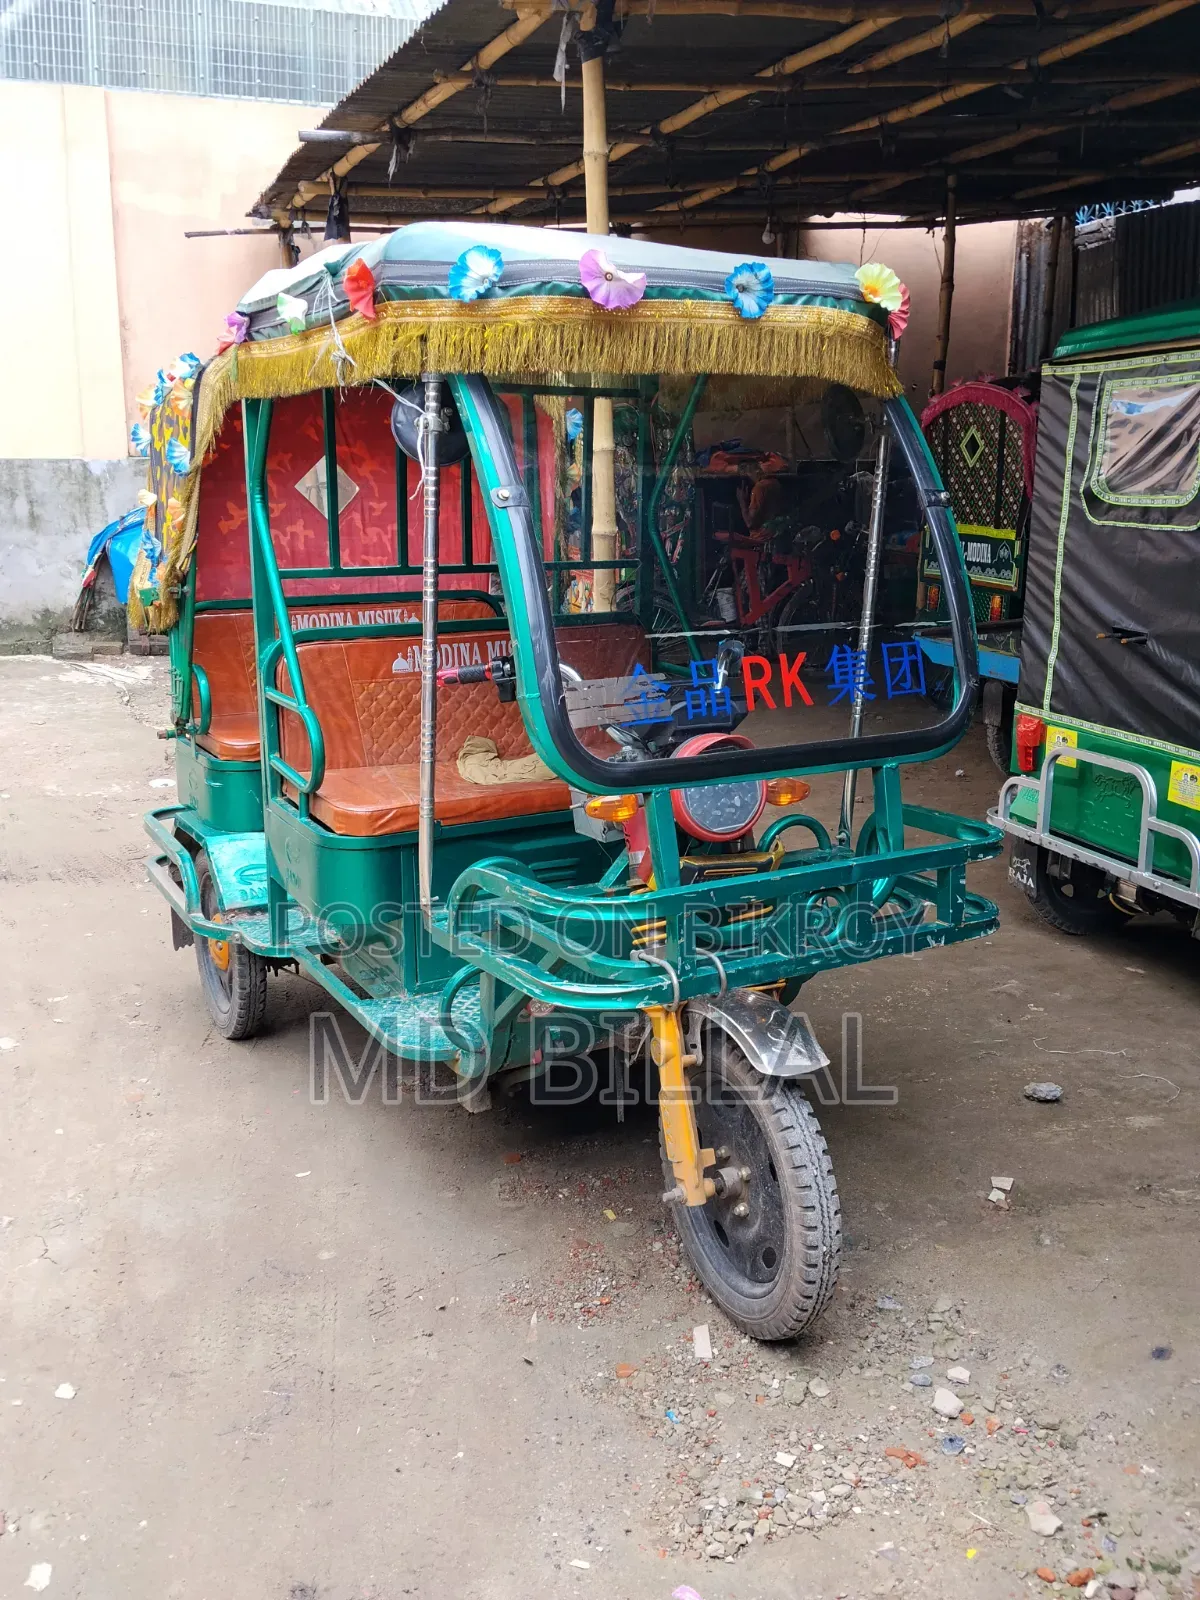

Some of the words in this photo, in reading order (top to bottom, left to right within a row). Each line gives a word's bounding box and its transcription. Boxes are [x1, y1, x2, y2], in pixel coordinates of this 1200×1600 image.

[295, 611, 353, 630] MODINA
[358, 608, 402, 626] MISUK
[412, 641, 482, 673] MDINA
